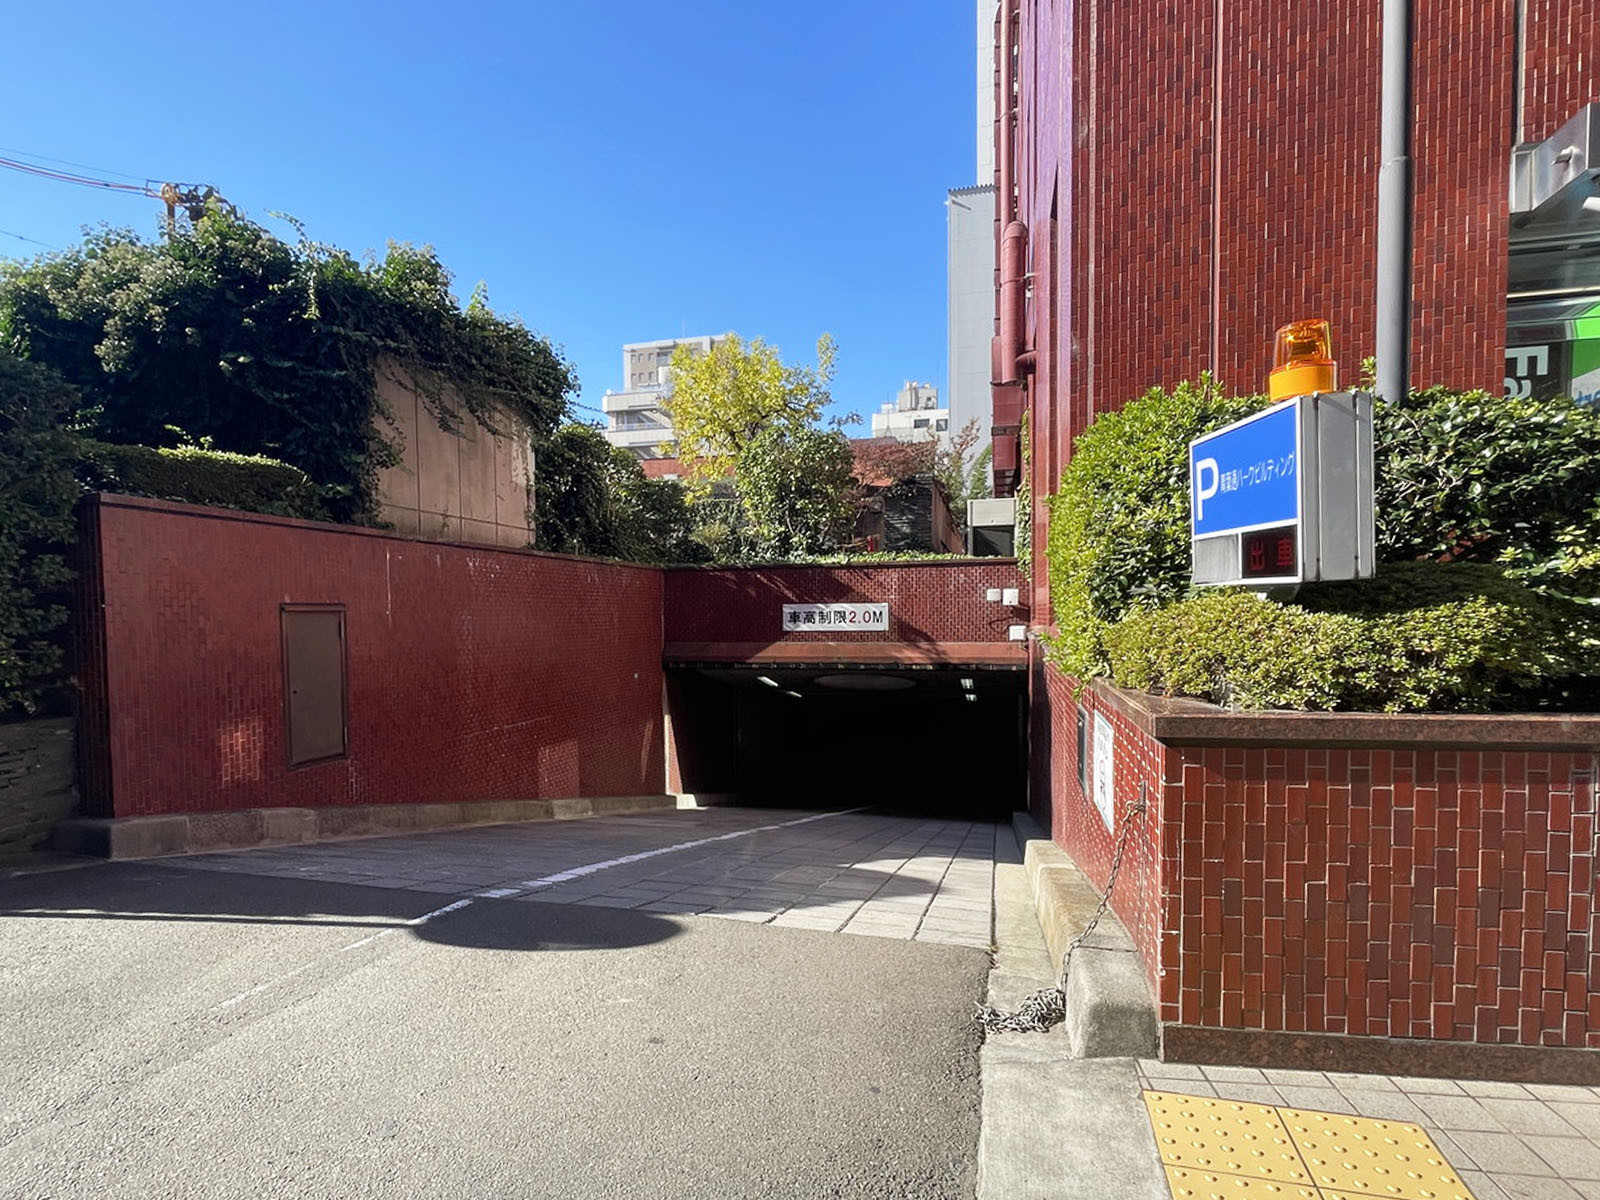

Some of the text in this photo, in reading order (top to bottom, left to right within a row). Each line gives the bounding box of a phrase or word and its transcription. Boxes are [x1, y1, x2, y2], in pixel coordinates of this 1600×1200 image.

[1196, 457, 1219, 520] P
[1251, 537, 1293, 570] 出車
[788, 610, 882, 624] 車高制限2.0M
